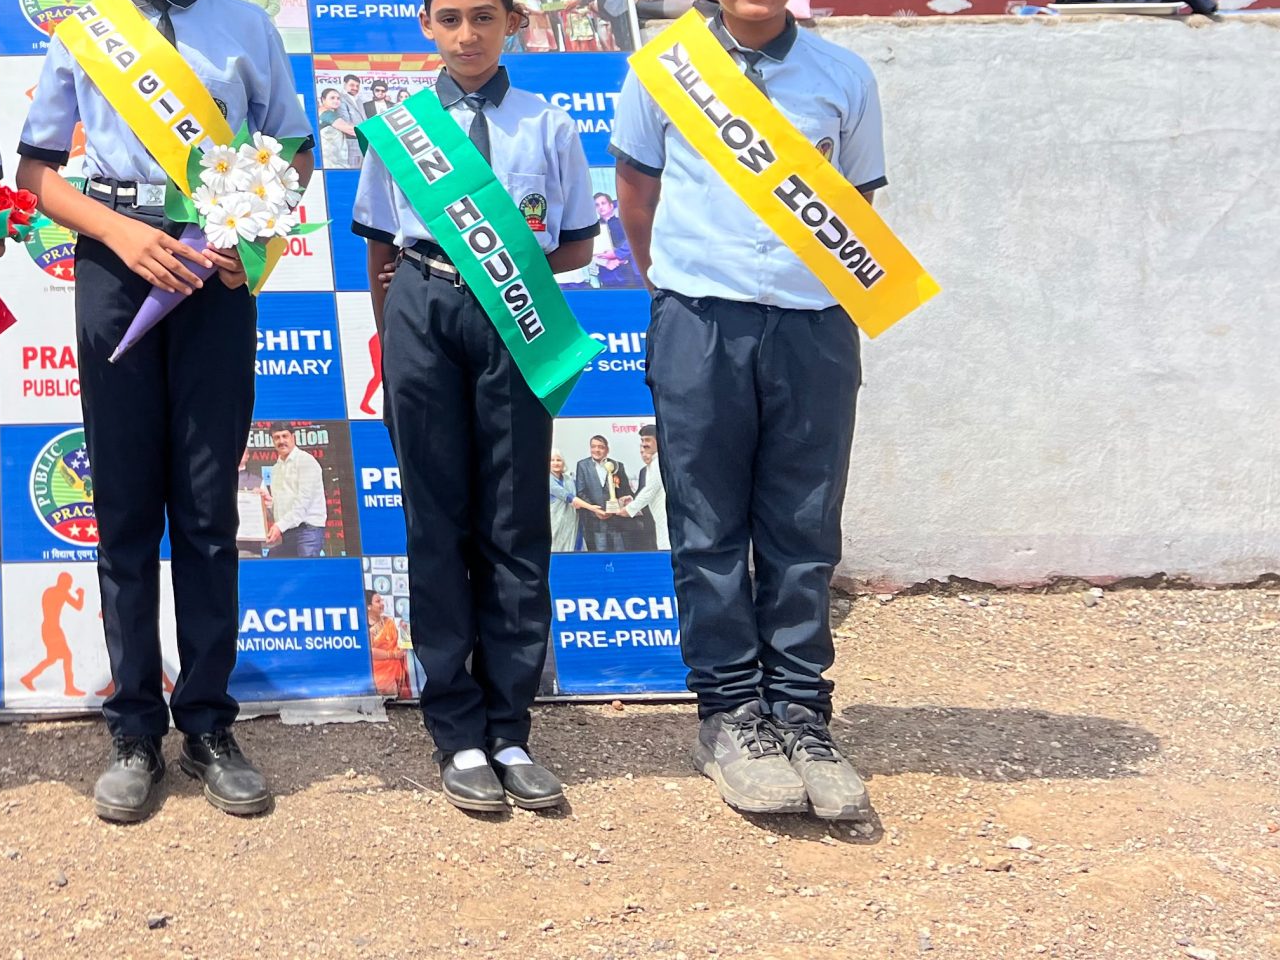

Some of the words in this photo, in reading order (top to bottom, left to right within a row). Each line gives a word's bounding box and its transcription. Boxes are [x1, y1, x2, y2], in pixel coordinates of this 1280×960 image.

[37, 8, 77, 22] PRAC
[316, 3, 423, 18] PRE-PRIM
[77, 5, 135, 69] HEAD
[138, 74, 202, 144] GIR
[660, 44, 777, 174] YELLOW
[774, 174, 885, 289] HOUSE
[382, 107, 451, 182] EEN
[447, 199, 542, 341] HOUSE
[22, 346, 76, 369] PRA
[35, 442, 63, 507] PUBLIC
[364, 494, 402, 507] INTER
[52, 505, 95, 524] PRAC
[237, 608, 359, 632] ACHITI
[237, 637, 302, 651] NATIONAL
[305, 635, 361, 650] SCHOOL
